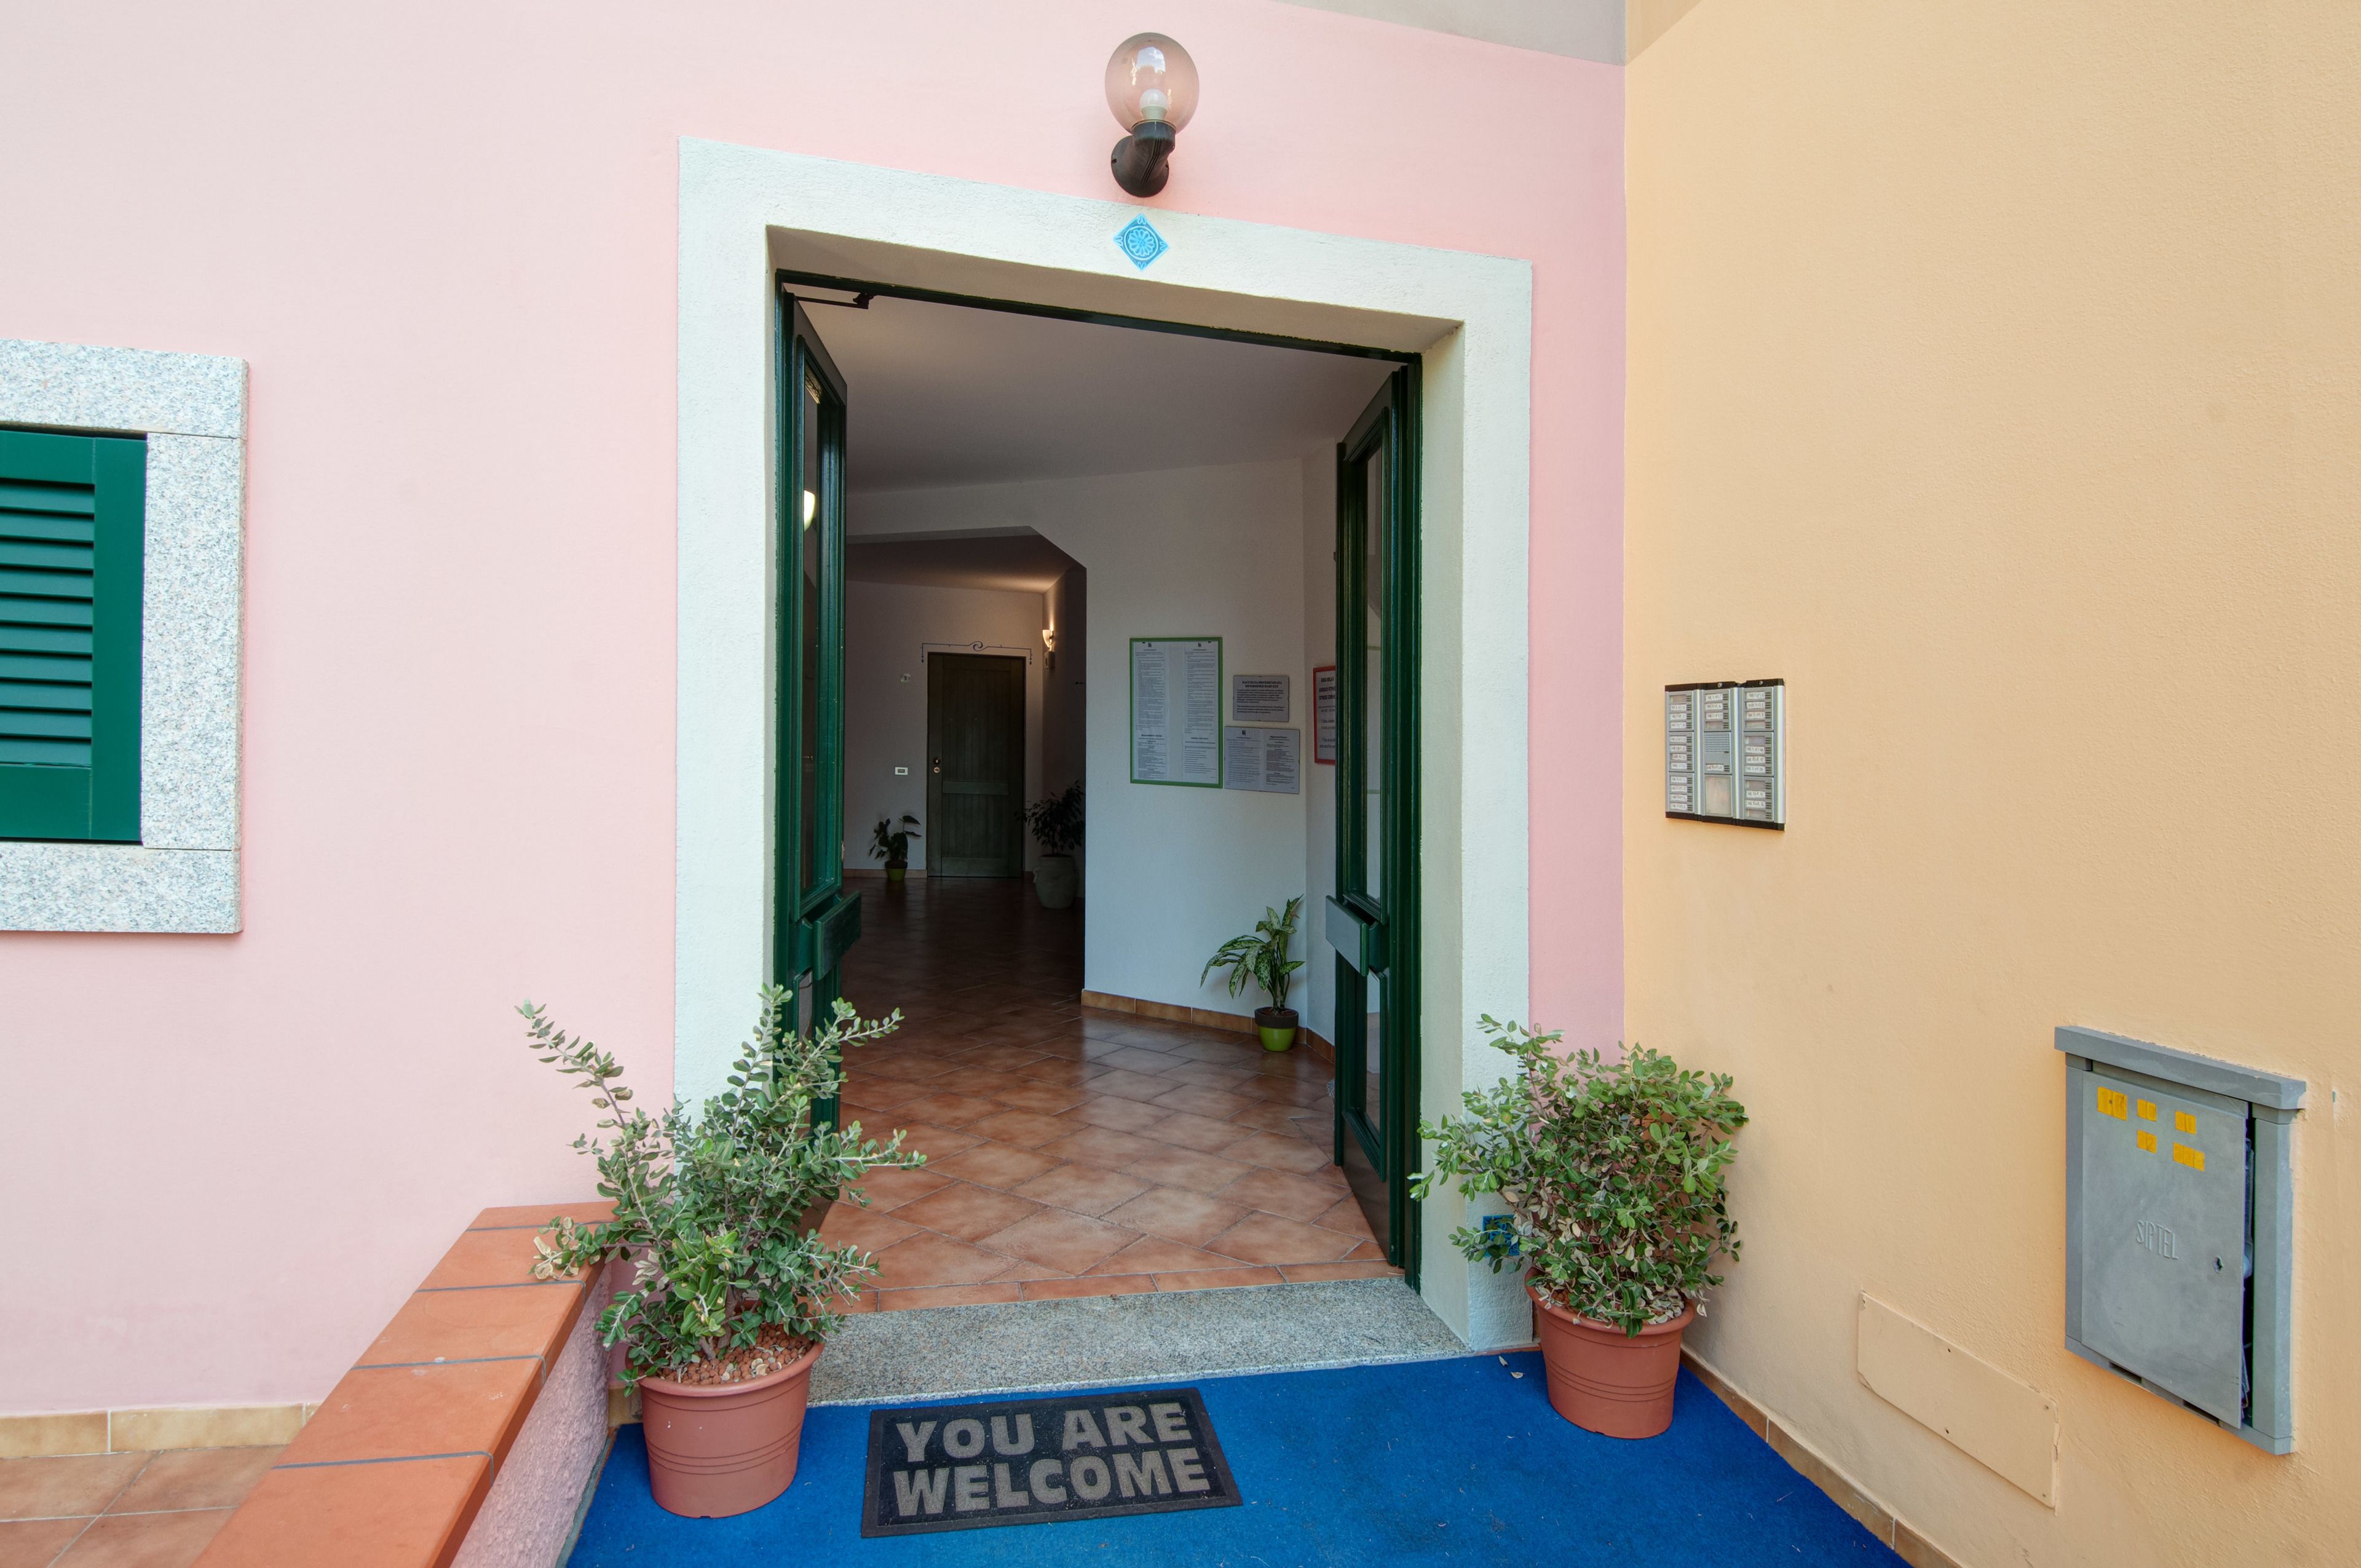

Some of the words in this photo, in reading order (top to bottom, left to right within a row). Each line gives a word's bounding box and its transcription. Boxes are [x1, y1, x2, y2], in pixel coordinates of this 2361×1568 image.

[2135, 1219, 2179, 1260] SIPTEL
[896, 1414, 1035, 1463] YOU
[1062, 1402, 1194, 1451] ARE
[893, 1447, 1211, 1517] WELCOME
